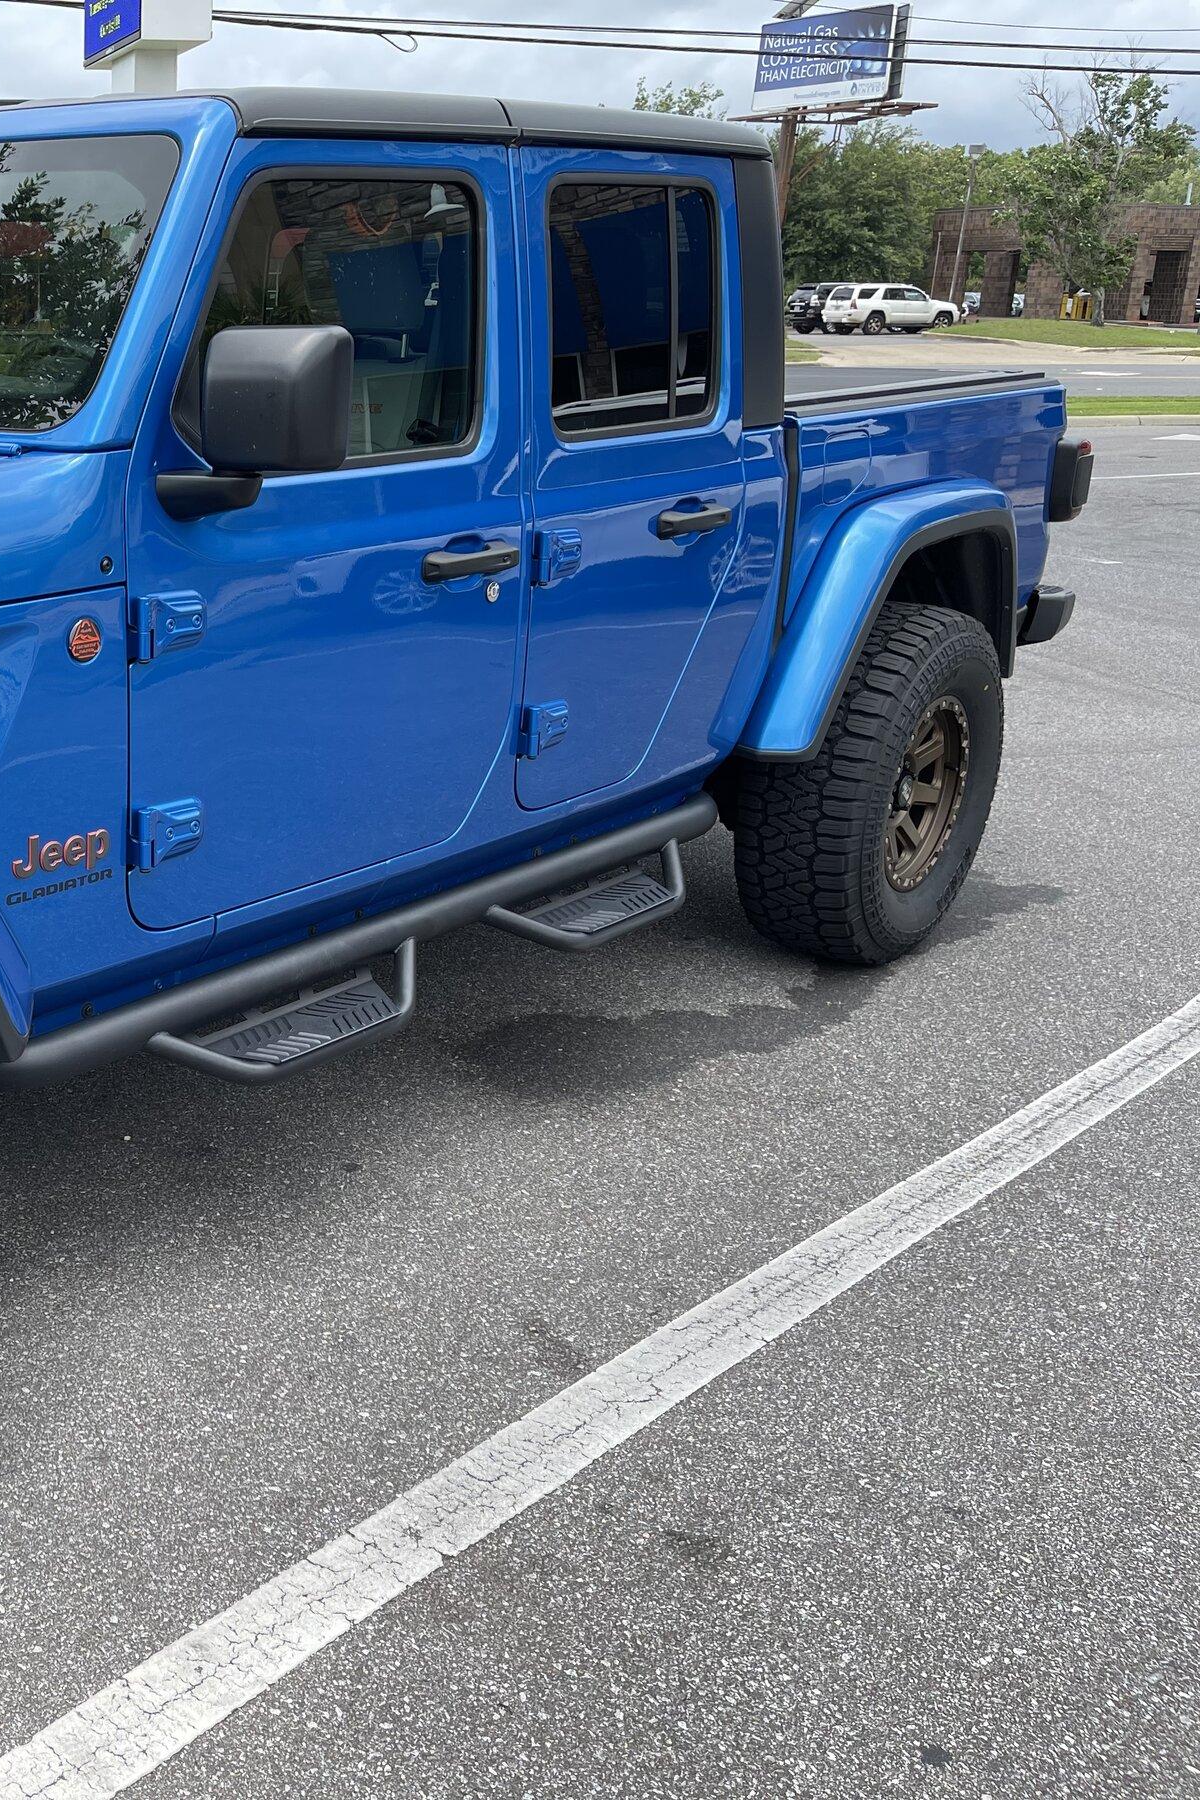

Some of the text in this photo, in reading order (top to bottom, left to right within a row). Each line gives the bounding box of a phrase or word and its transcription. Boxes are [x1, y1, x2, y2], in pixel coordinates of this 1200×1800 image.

[764, 25, 839, 50] Natural Gas
[761, 42, 838, 68] COSTS LESS
[760, 67, 789, 83] THAN
[11, 828, 110, 879] Jeep
[6, 868, 113, 906] GLADIATOR
